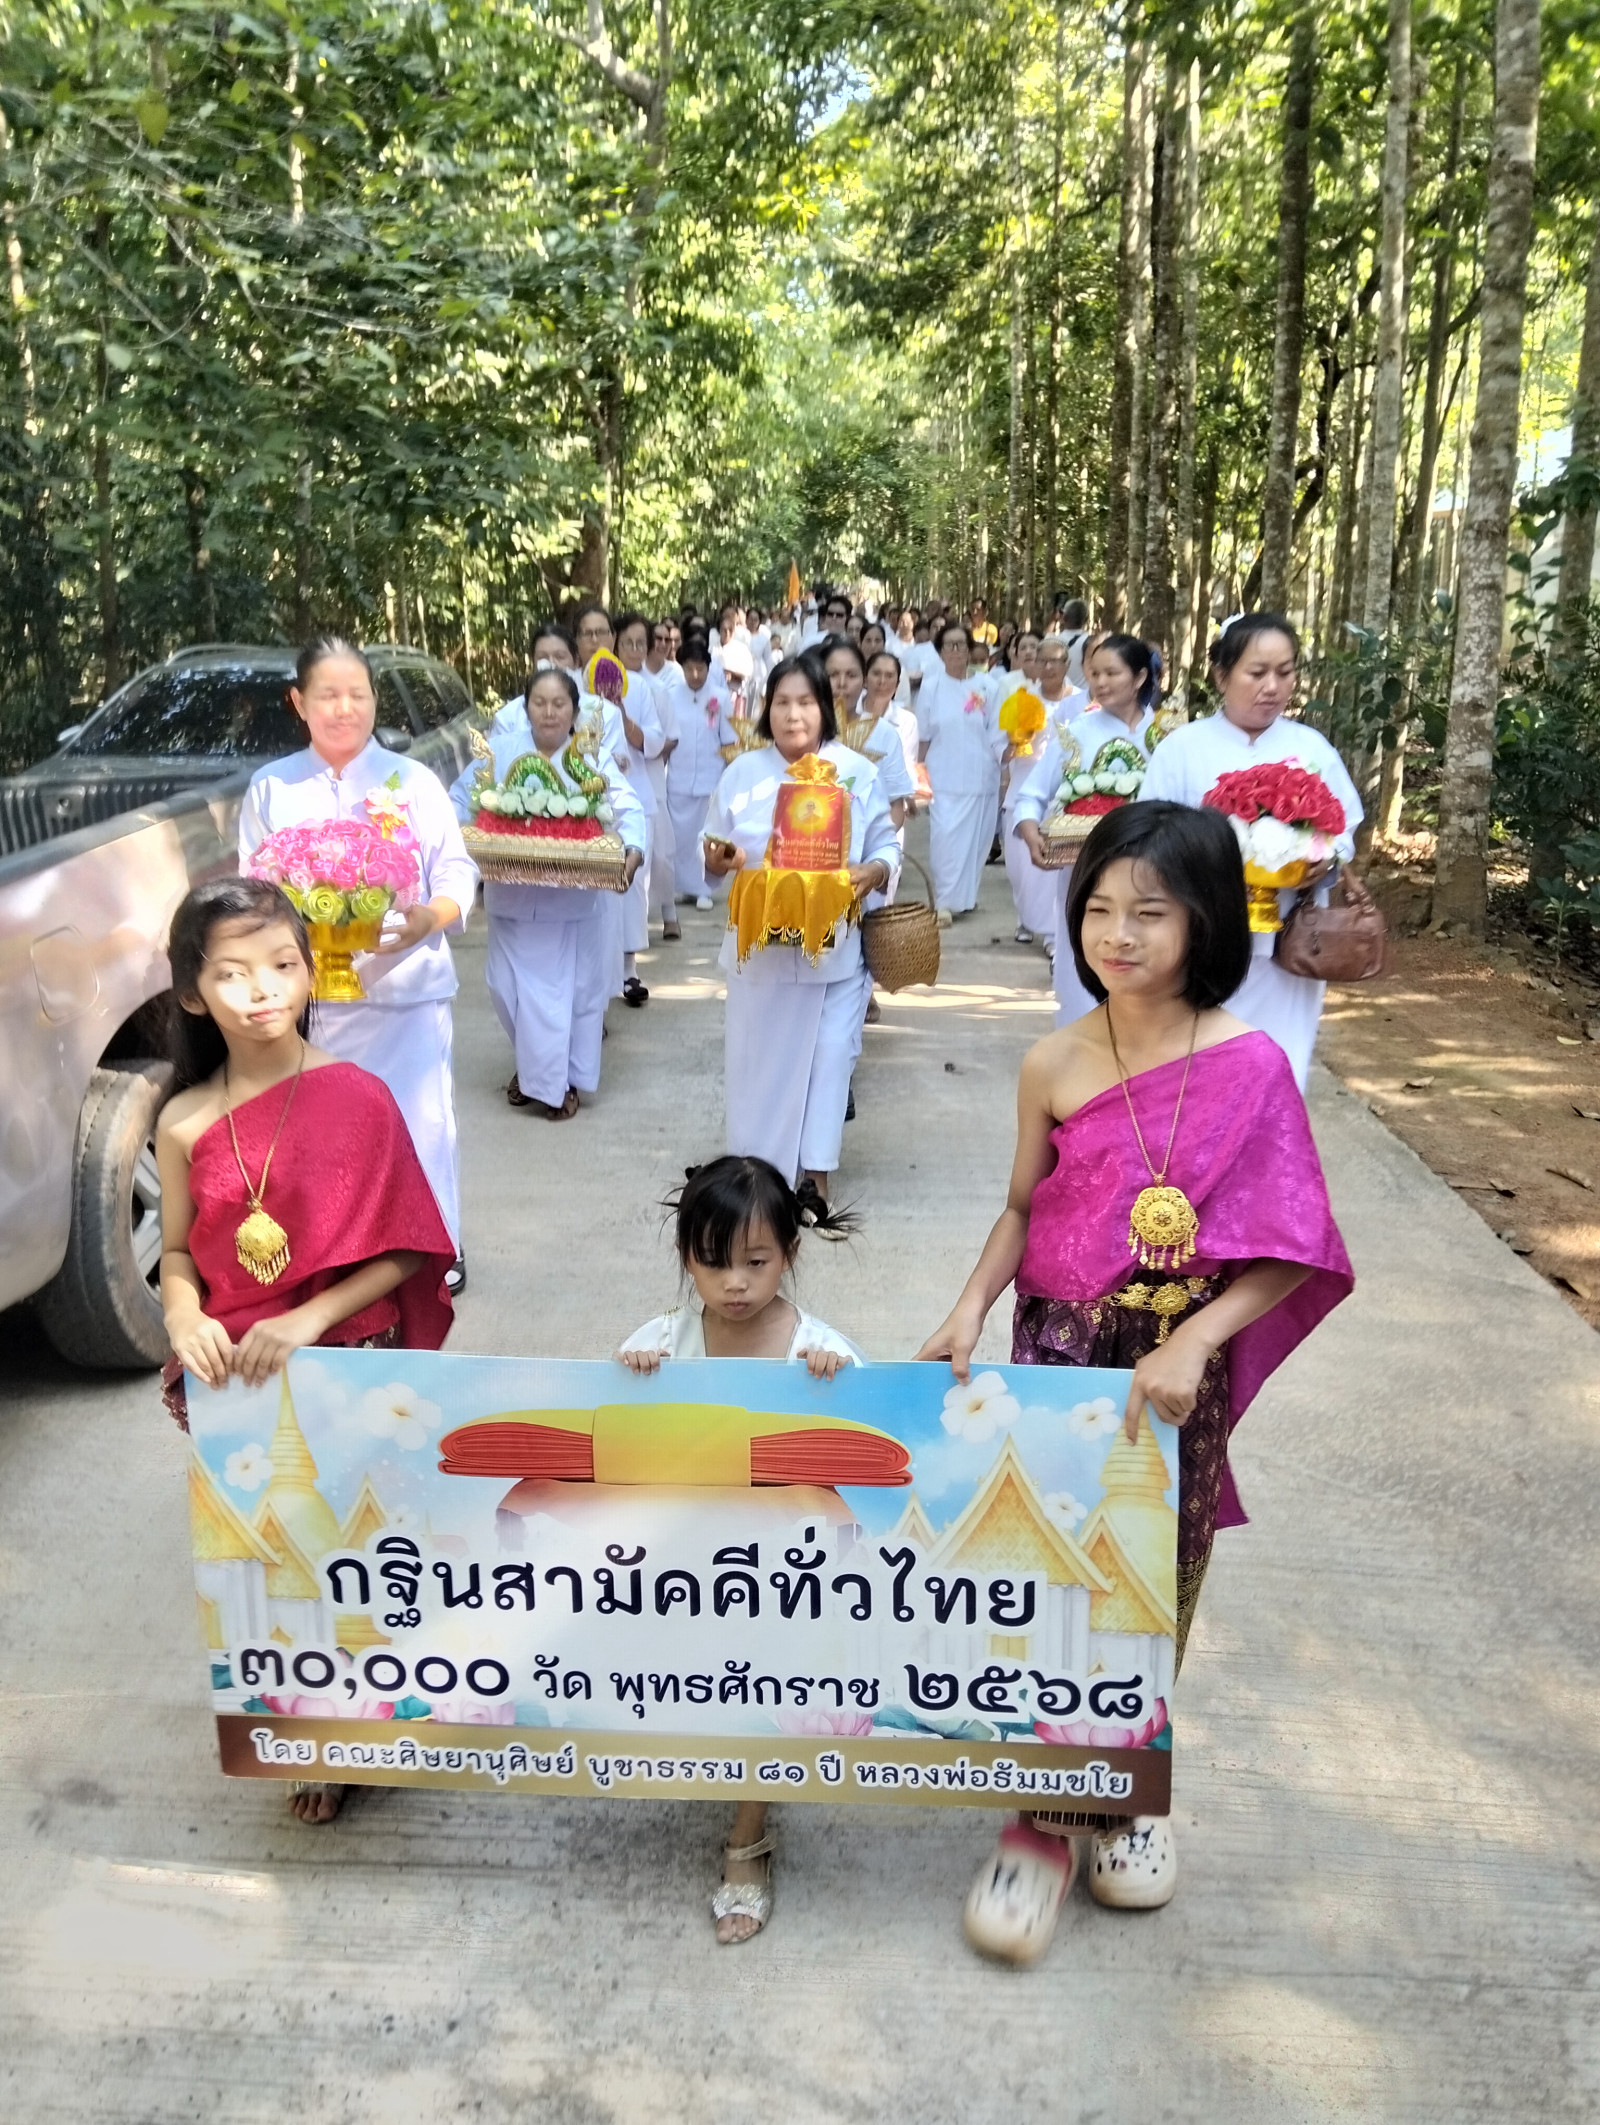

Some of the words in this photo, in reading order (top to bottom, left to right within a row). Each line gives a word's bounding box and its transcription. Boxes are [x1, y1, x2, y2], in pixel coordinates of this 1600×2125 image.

[326, 1526, 1036, 1629] กฐินสามัคคีทั่วไทย
[240, 1647, 511, 1700] ๓๐,๐๐๐
[532, 1653, 592, 1701] วัด
[609, 1660, 881, 1720] พุทธศักราช
[903, 1663, 1144, 1720] ๒๕๖๘
[255, 1732, 312, 1762] โดย
[328, 1739, 575, 1781] คณะศิษยานุศิษย์
[588, 1755, 744, 1786] บูชาธรรม
[758, 1760, 806, 1783] ๘๑
[819, 1753, 842, 1783] ปี
[856, 1759, 1129, 1795] หลวงพ่อธัมมชโย
